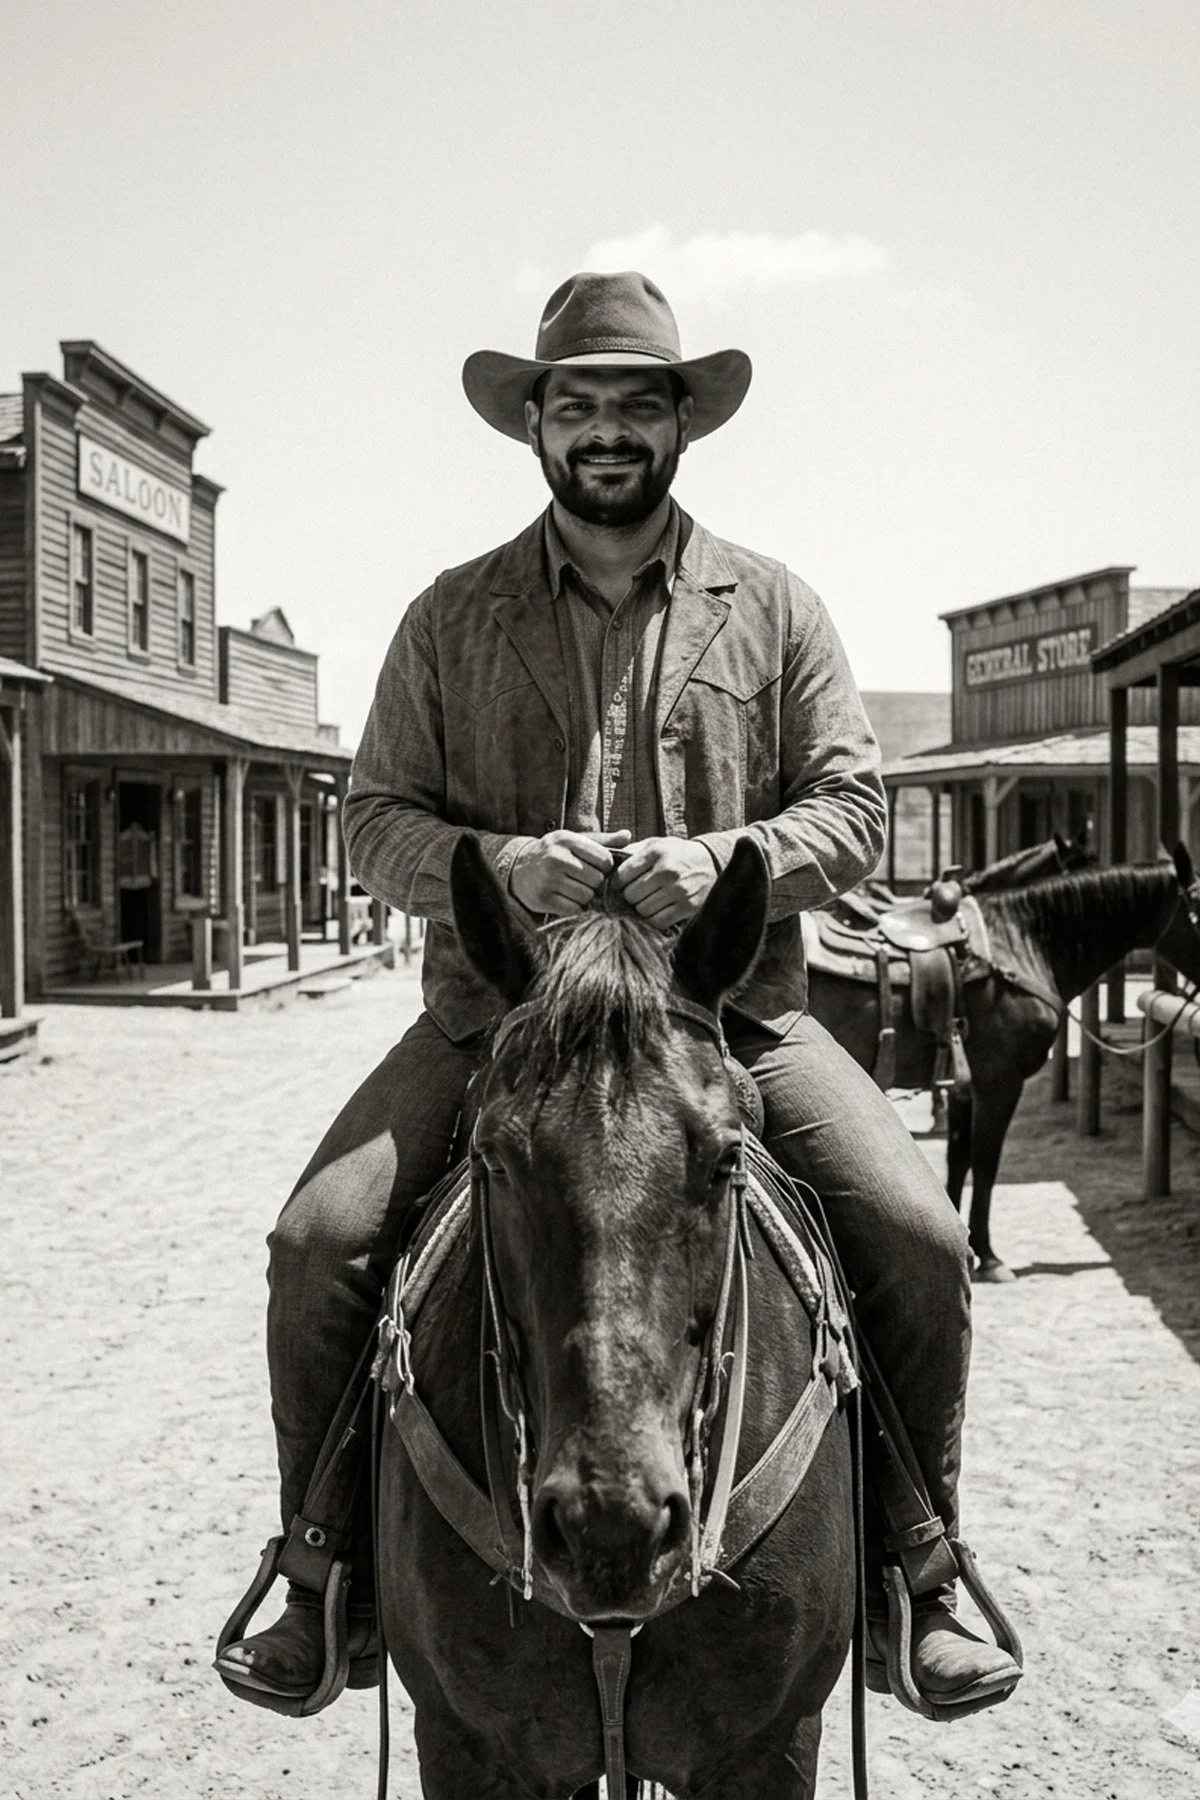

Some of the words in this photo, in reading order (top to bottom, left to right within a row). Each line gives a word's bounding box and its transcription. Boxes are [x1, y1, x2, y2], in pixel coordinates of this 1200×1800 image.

[90, 451, 182, 529] SALOON
[967, 642, 1033, 686] GENERAL
[1037, 628, 1092, 672] STORE
